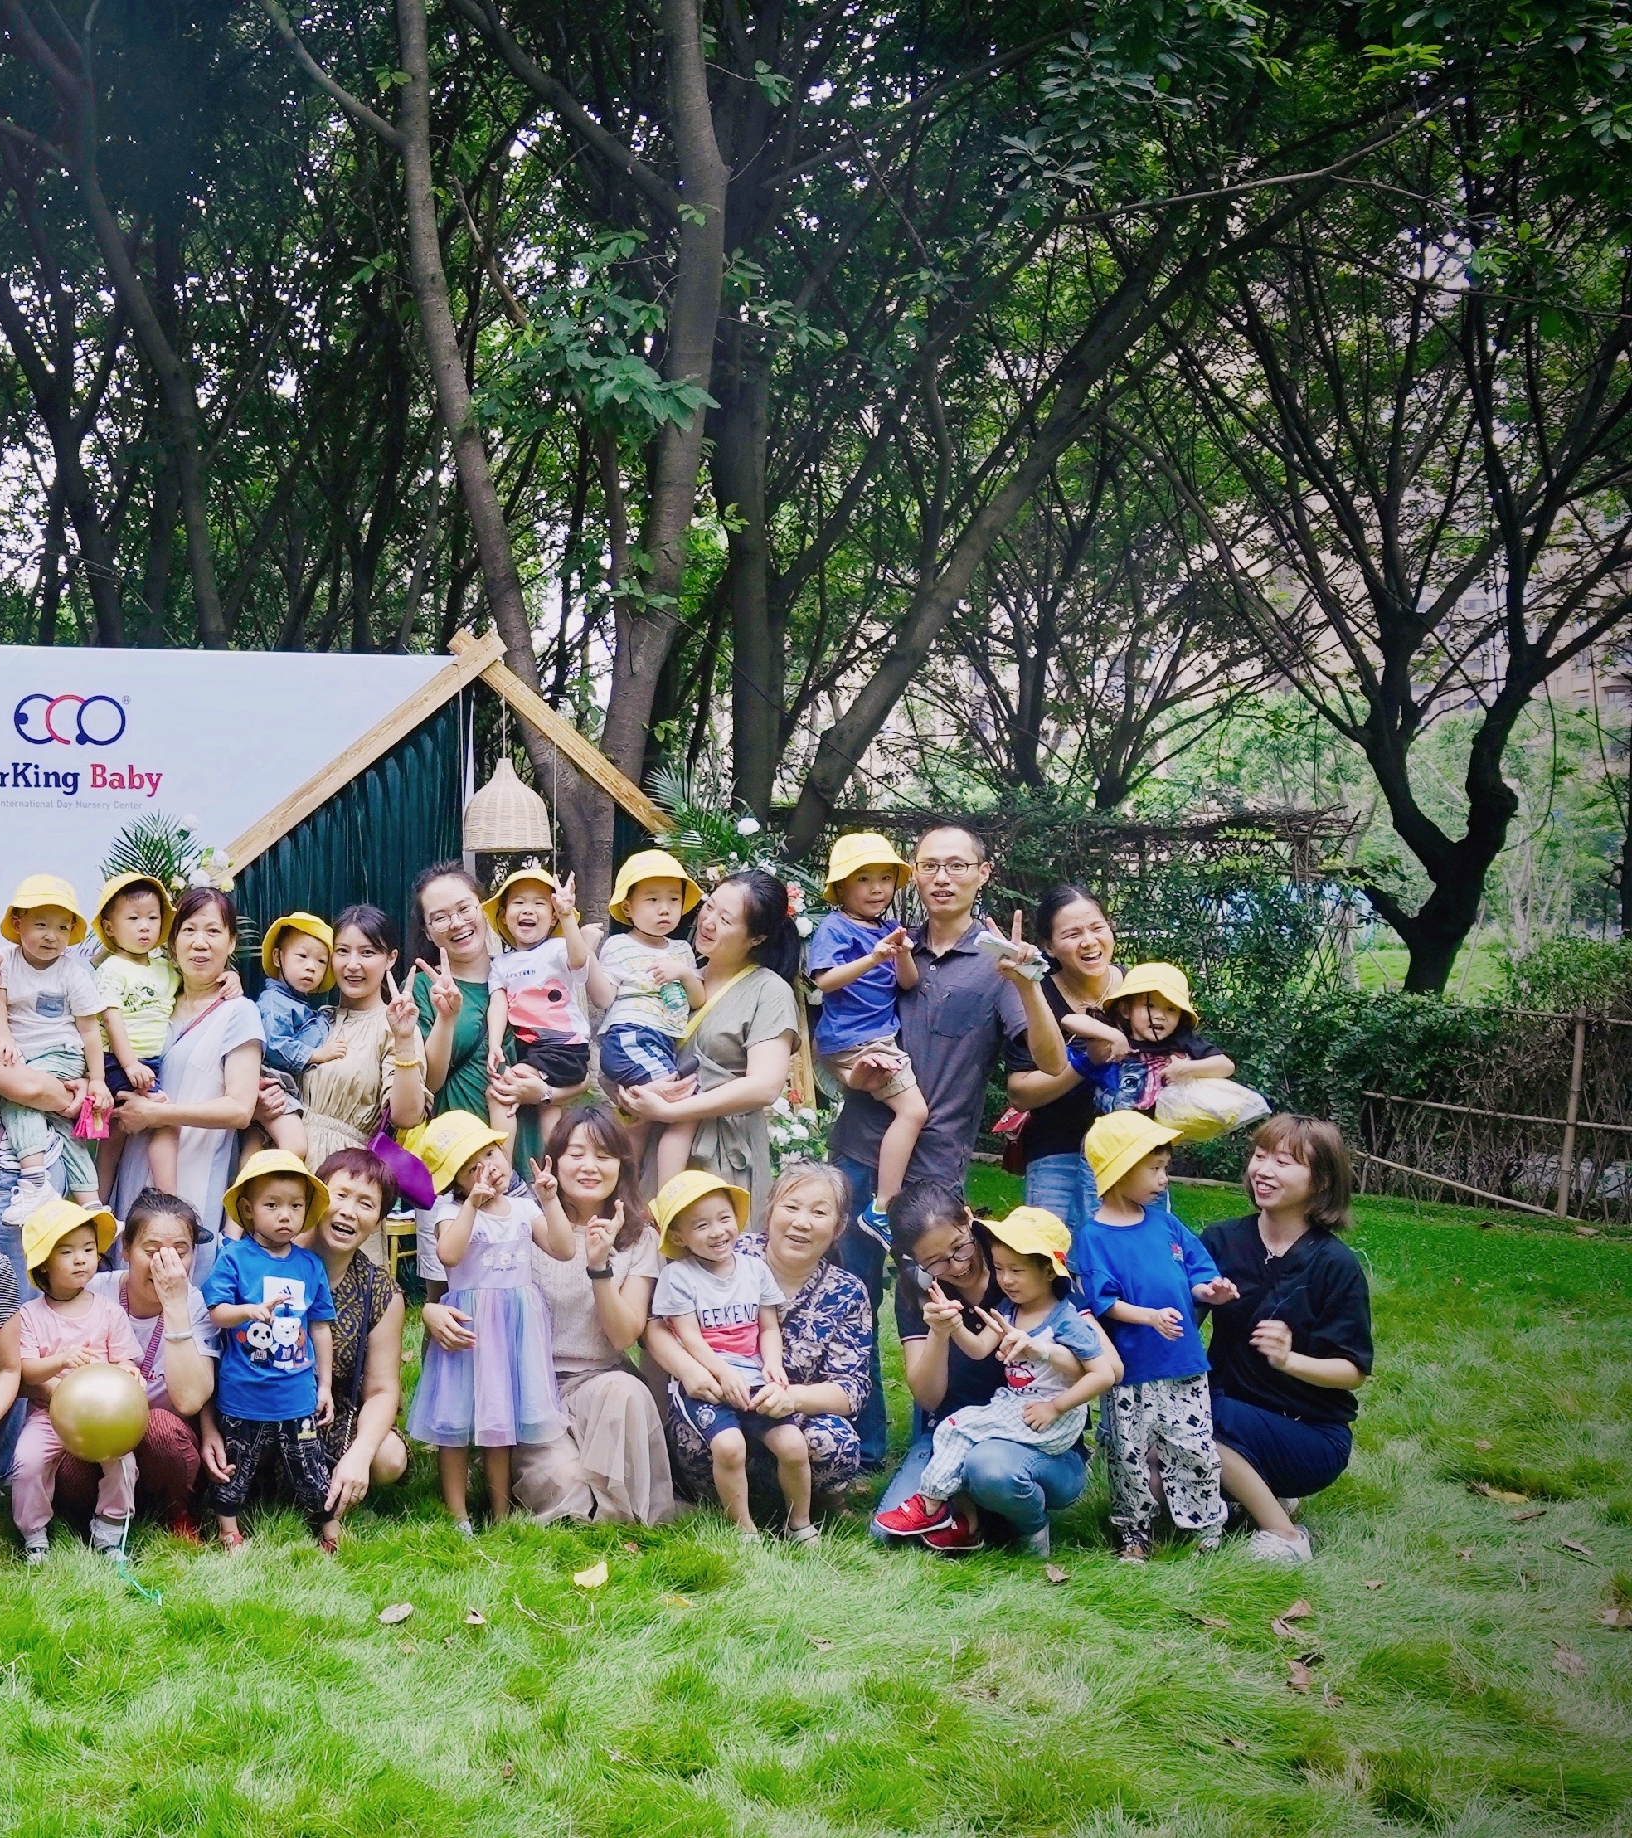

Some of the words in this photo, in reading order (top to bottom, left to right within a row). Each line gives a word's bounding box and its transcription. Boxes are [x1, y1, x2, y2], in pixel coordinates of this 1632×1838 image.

[90, 763, 163, 797] Baby
[56, 799, 72, 810] Day
[76, 800, 110, 810] Nursery
[114, 801, 142, 810] Center
[699, 1303, 758, 1328] EEKEND
